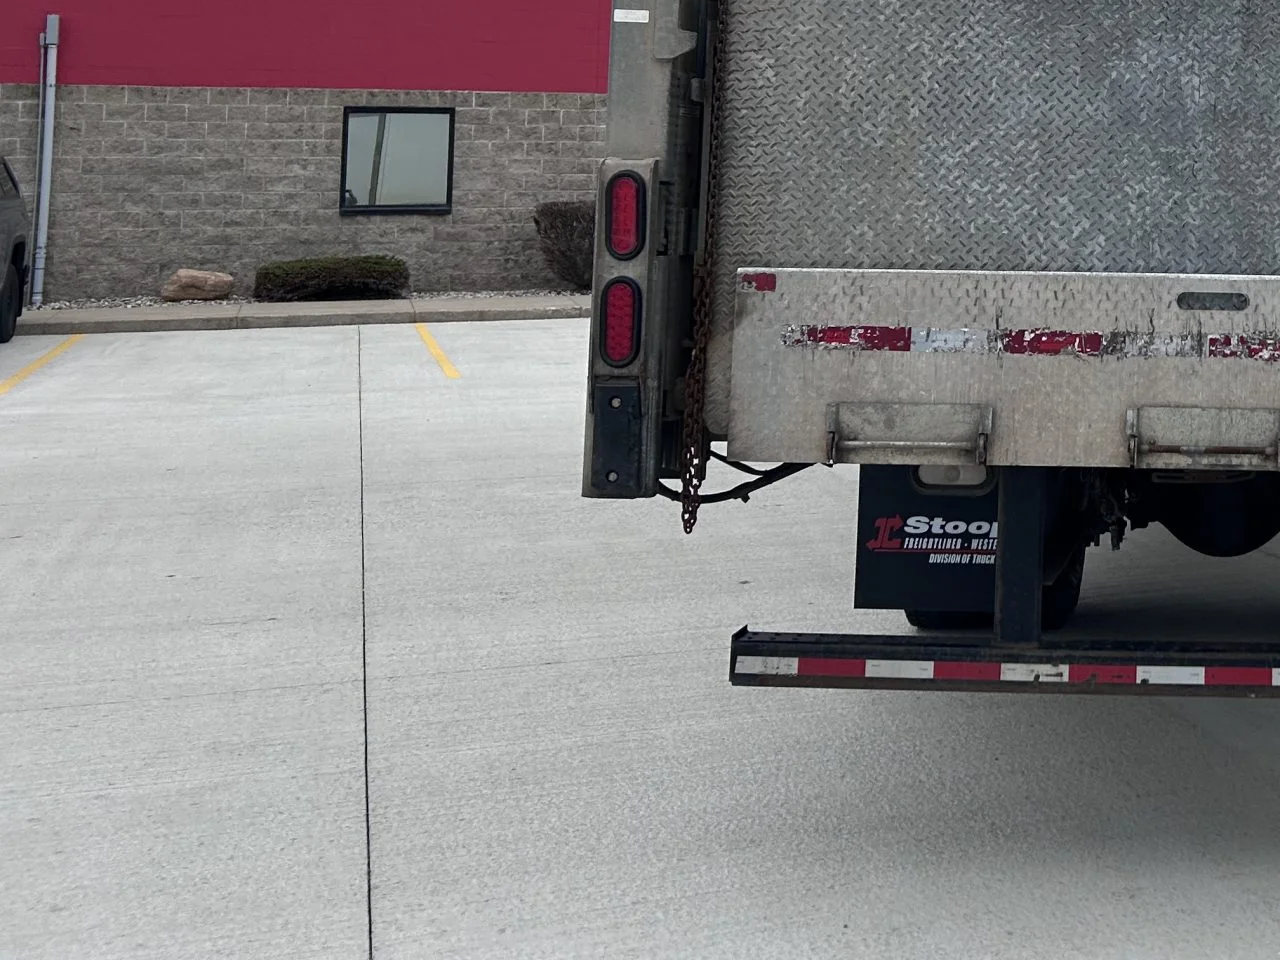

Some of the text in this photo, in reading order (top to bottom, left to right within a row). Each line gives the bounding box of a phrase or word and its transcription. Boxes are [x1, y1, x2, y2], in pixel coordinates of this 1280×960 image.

[904, 538, 962, 549] FREIGHTLINER
[929, 554, 996, 564] DIVISION OF TRUCK
